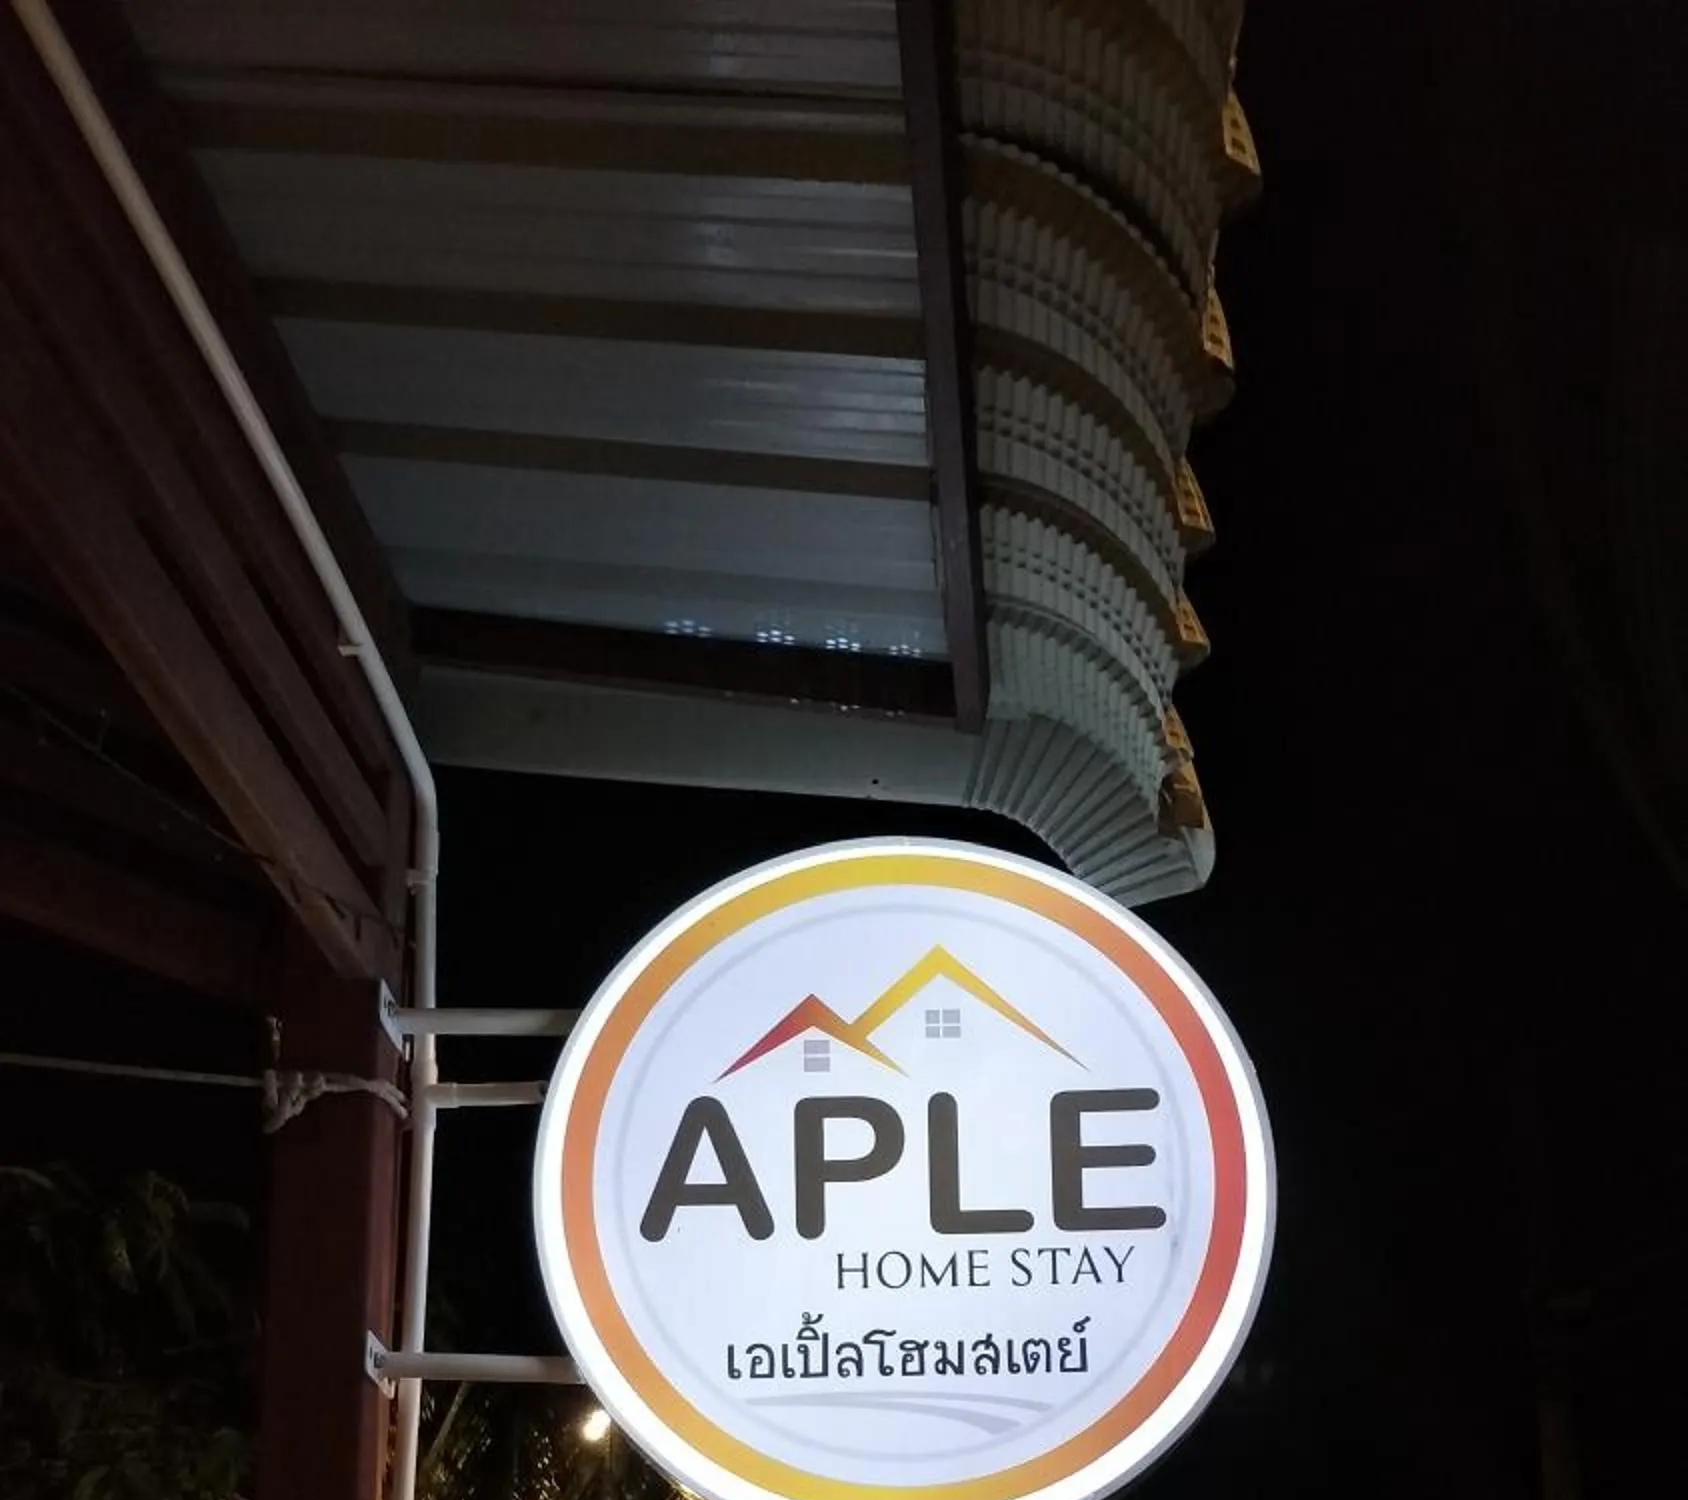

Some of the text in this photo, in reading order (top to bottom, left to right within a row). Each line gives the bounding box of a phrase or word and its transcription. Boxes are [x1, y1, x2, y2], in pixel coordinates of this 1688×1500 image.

[640, 1088, 1167, 1242] APLE
[836, 1245, 1136, 1291] HOME STAY
[727, 1311, 1091, 1380] เอเปิ้ลโฮมสเตย์
